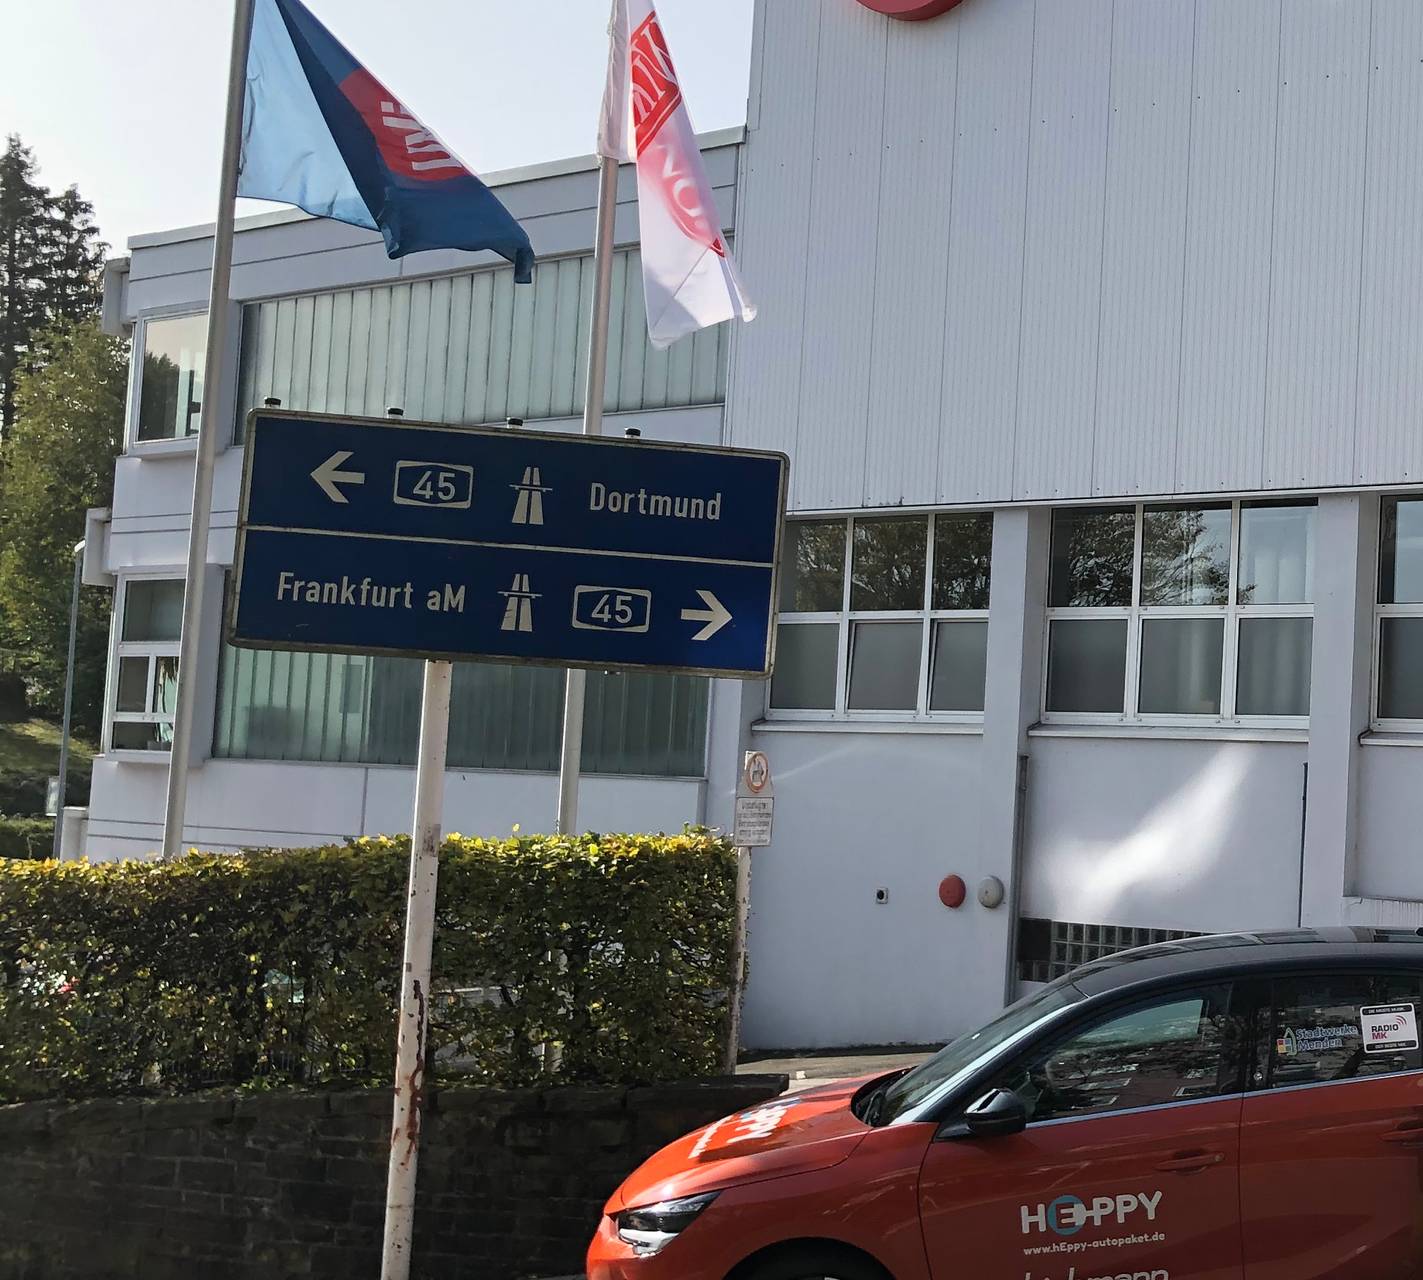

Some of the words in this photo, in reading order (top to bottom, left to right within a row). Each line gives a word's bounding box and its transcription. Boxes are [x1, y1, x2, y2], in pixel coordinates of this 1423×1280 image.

[412, 470, 457, 502] 45
[589, 481, 723, 521] Dortmund
[276, 571, 414, 610] Frankfurt
[426, 584, 467, 613] aM
[589, 593, 634, 626] 45
[1295, 1023, 1358, 1040] Stadtwerke
[1371, 1023, 1399, 1033] RADIO
[1371, 1032, 1388, 1040] MK
[1297, 1037, 1343, 1052] Menden
[1020, 1190, 1163, 1234] HEPPY
[1023, 1231, 1166, 1256] www.hEppy-autopaket.de
